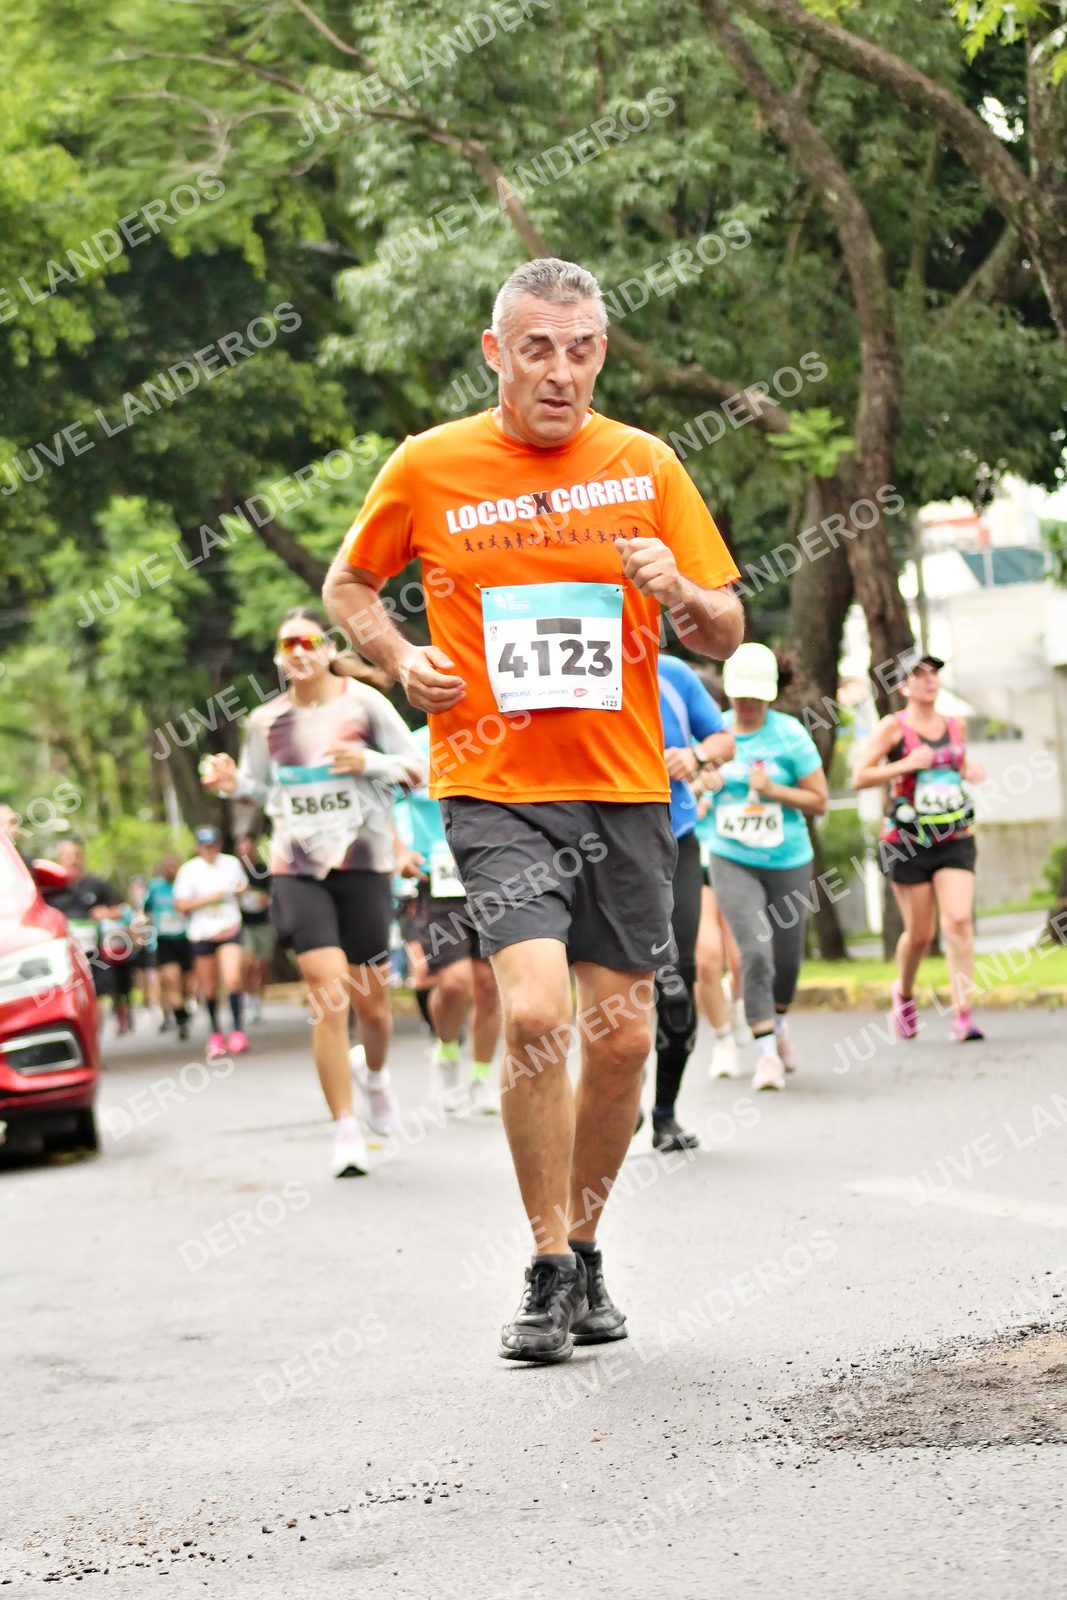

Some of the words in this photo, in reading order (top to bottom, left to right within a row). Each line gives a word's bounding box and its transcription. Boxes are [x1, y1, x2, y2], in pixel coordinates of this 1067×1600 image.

[498, 639, 613, 679] 4123
[291, 791, 351, 815] 5865
[723, 815, 777, 832] 4776
